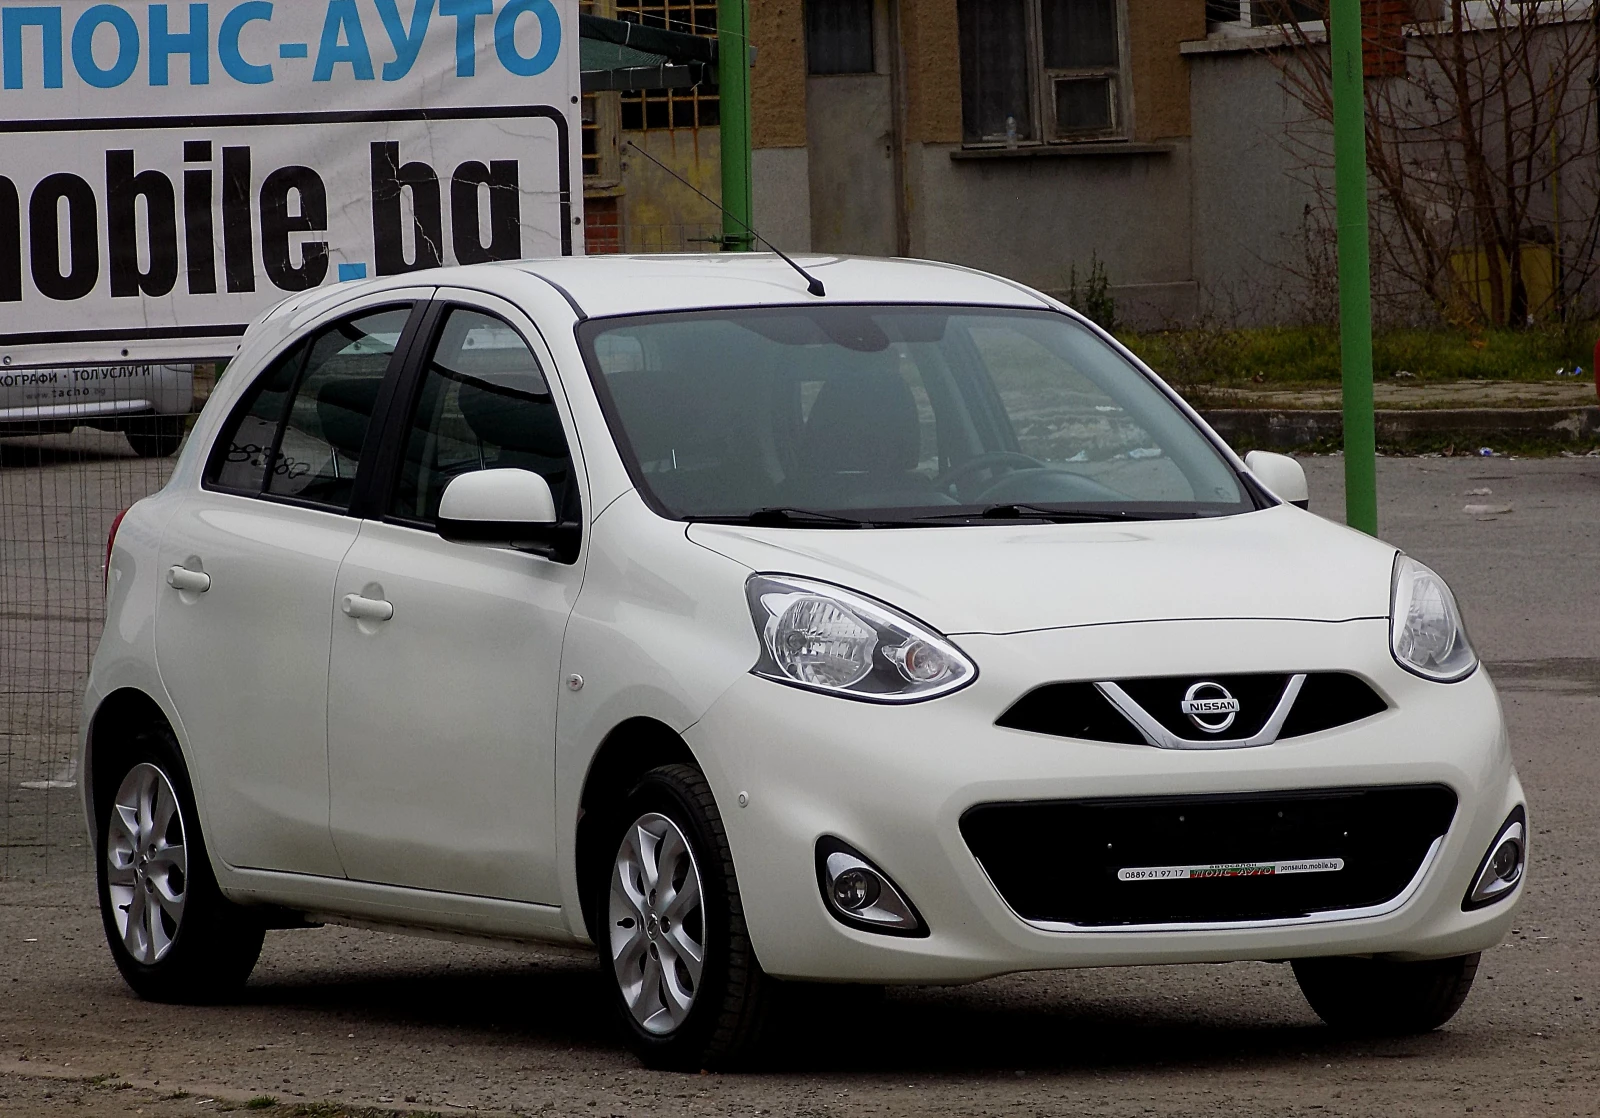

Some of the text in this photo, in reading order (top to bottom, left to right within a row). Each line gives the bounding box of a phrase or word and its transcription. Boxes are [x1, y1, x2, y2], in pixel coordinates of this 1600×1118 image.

[3, 0, 561, 90] ПОНС-АУТО
[0, 141, 522, 301] obile.bg
[1190, 702, 1234, 711] NISSAN
[1237, 866, 1273, 876] АУТО
[1280, 862, 1338, 872] ponsauto.mobile.bg
[1175, 869, 1184, 877] 17
